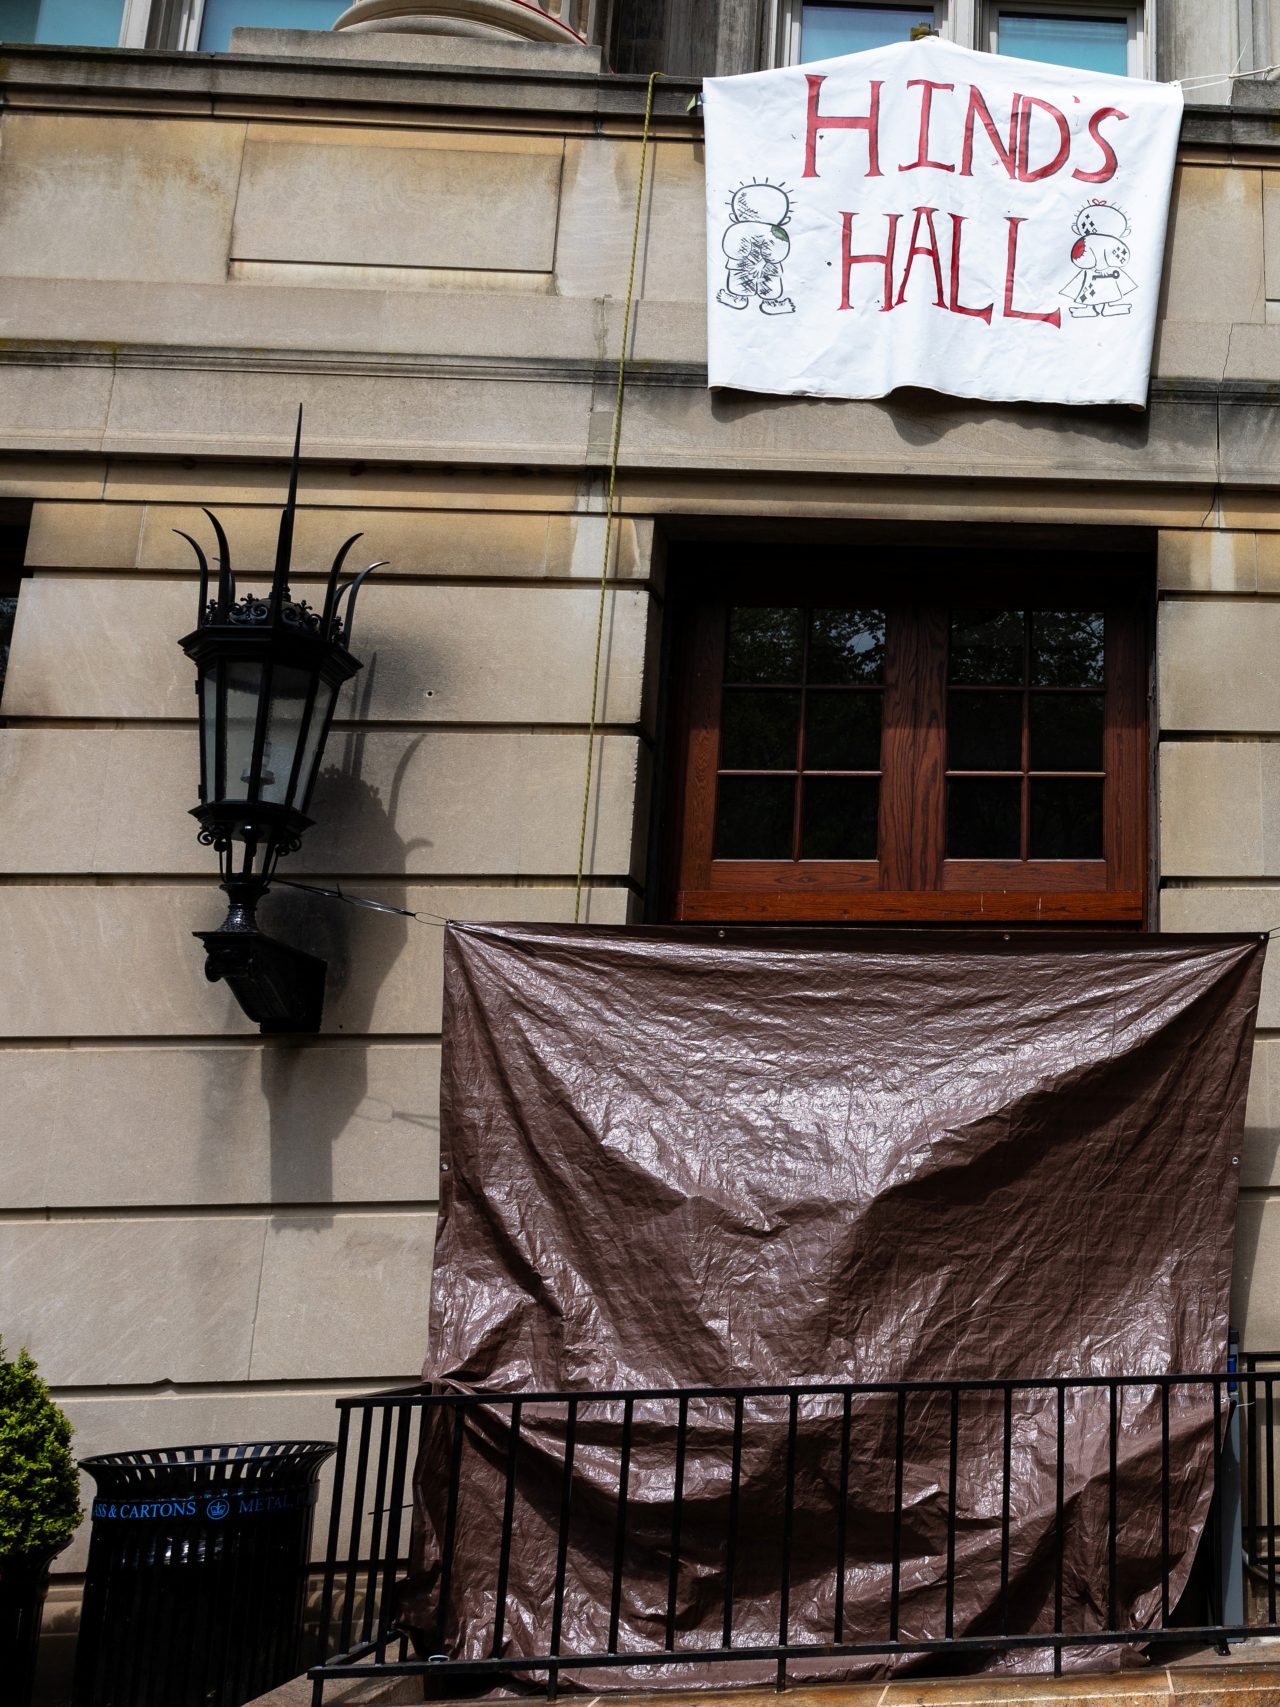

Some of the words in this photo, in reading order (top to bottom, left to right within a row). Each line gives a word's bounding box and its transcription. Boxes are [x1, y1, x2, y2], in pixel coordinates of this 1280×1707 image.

[801, 74, 1129, 183] HIND'S
[837, 206, 1061, 329] HALL
[109, 1504, 117, 1518] &
[120, 1502, 196, 1519] CARTONS
